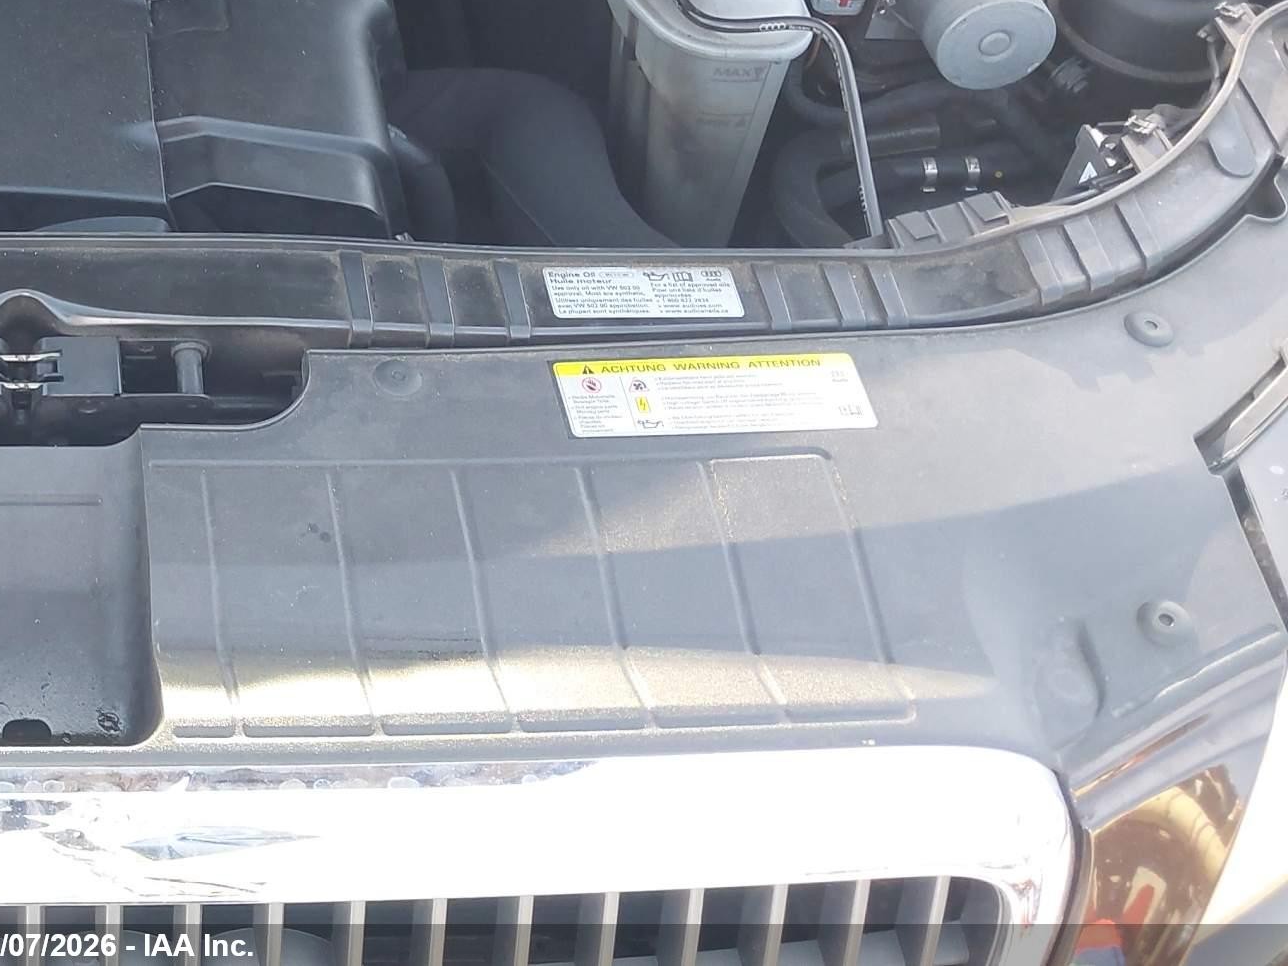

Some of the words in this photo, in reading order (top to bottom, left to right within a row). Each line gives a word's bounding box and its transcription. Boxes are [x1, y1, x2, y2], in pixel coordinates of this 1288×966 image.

[548, 271, 580, 279] Engine
[601, 364, 666, 374] ACHTUNG
[673, 361, 740, 371] WARNING
[748, 359, 821, 369] ATTENTION
